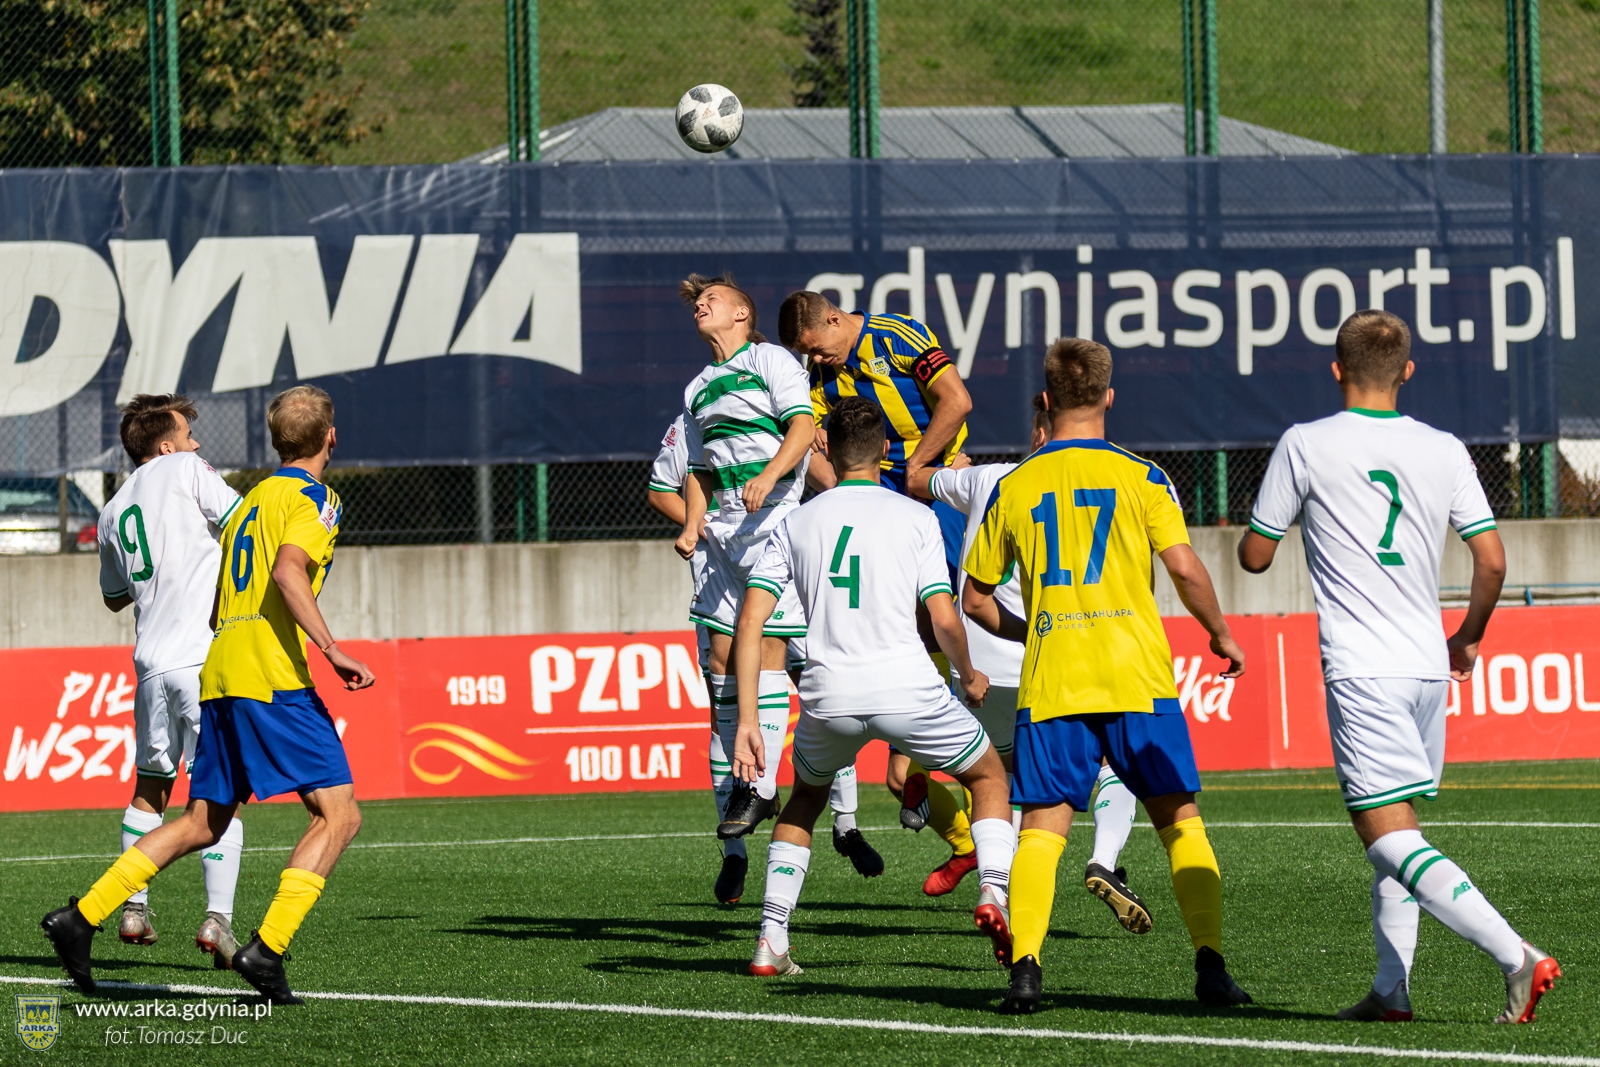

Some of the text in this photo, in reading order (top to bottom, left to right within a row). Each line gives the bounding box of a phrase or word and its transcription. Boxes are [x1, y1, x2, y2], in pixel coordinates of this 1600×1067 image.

[118, 503, 154, 582] 9
[231, 505, 259, 593] 6
[1030, 488, 1117, 587] 17
[1368, 469, 1406, 566] 2
[828, 525, 860, 609] 4
[1058, 622, 1095, 630] PUEBLA
[446, 675, 507, 706] 1919
[529, 643, 711, 715] PZPN
[566, 743, 686, 782] 100 LAT
